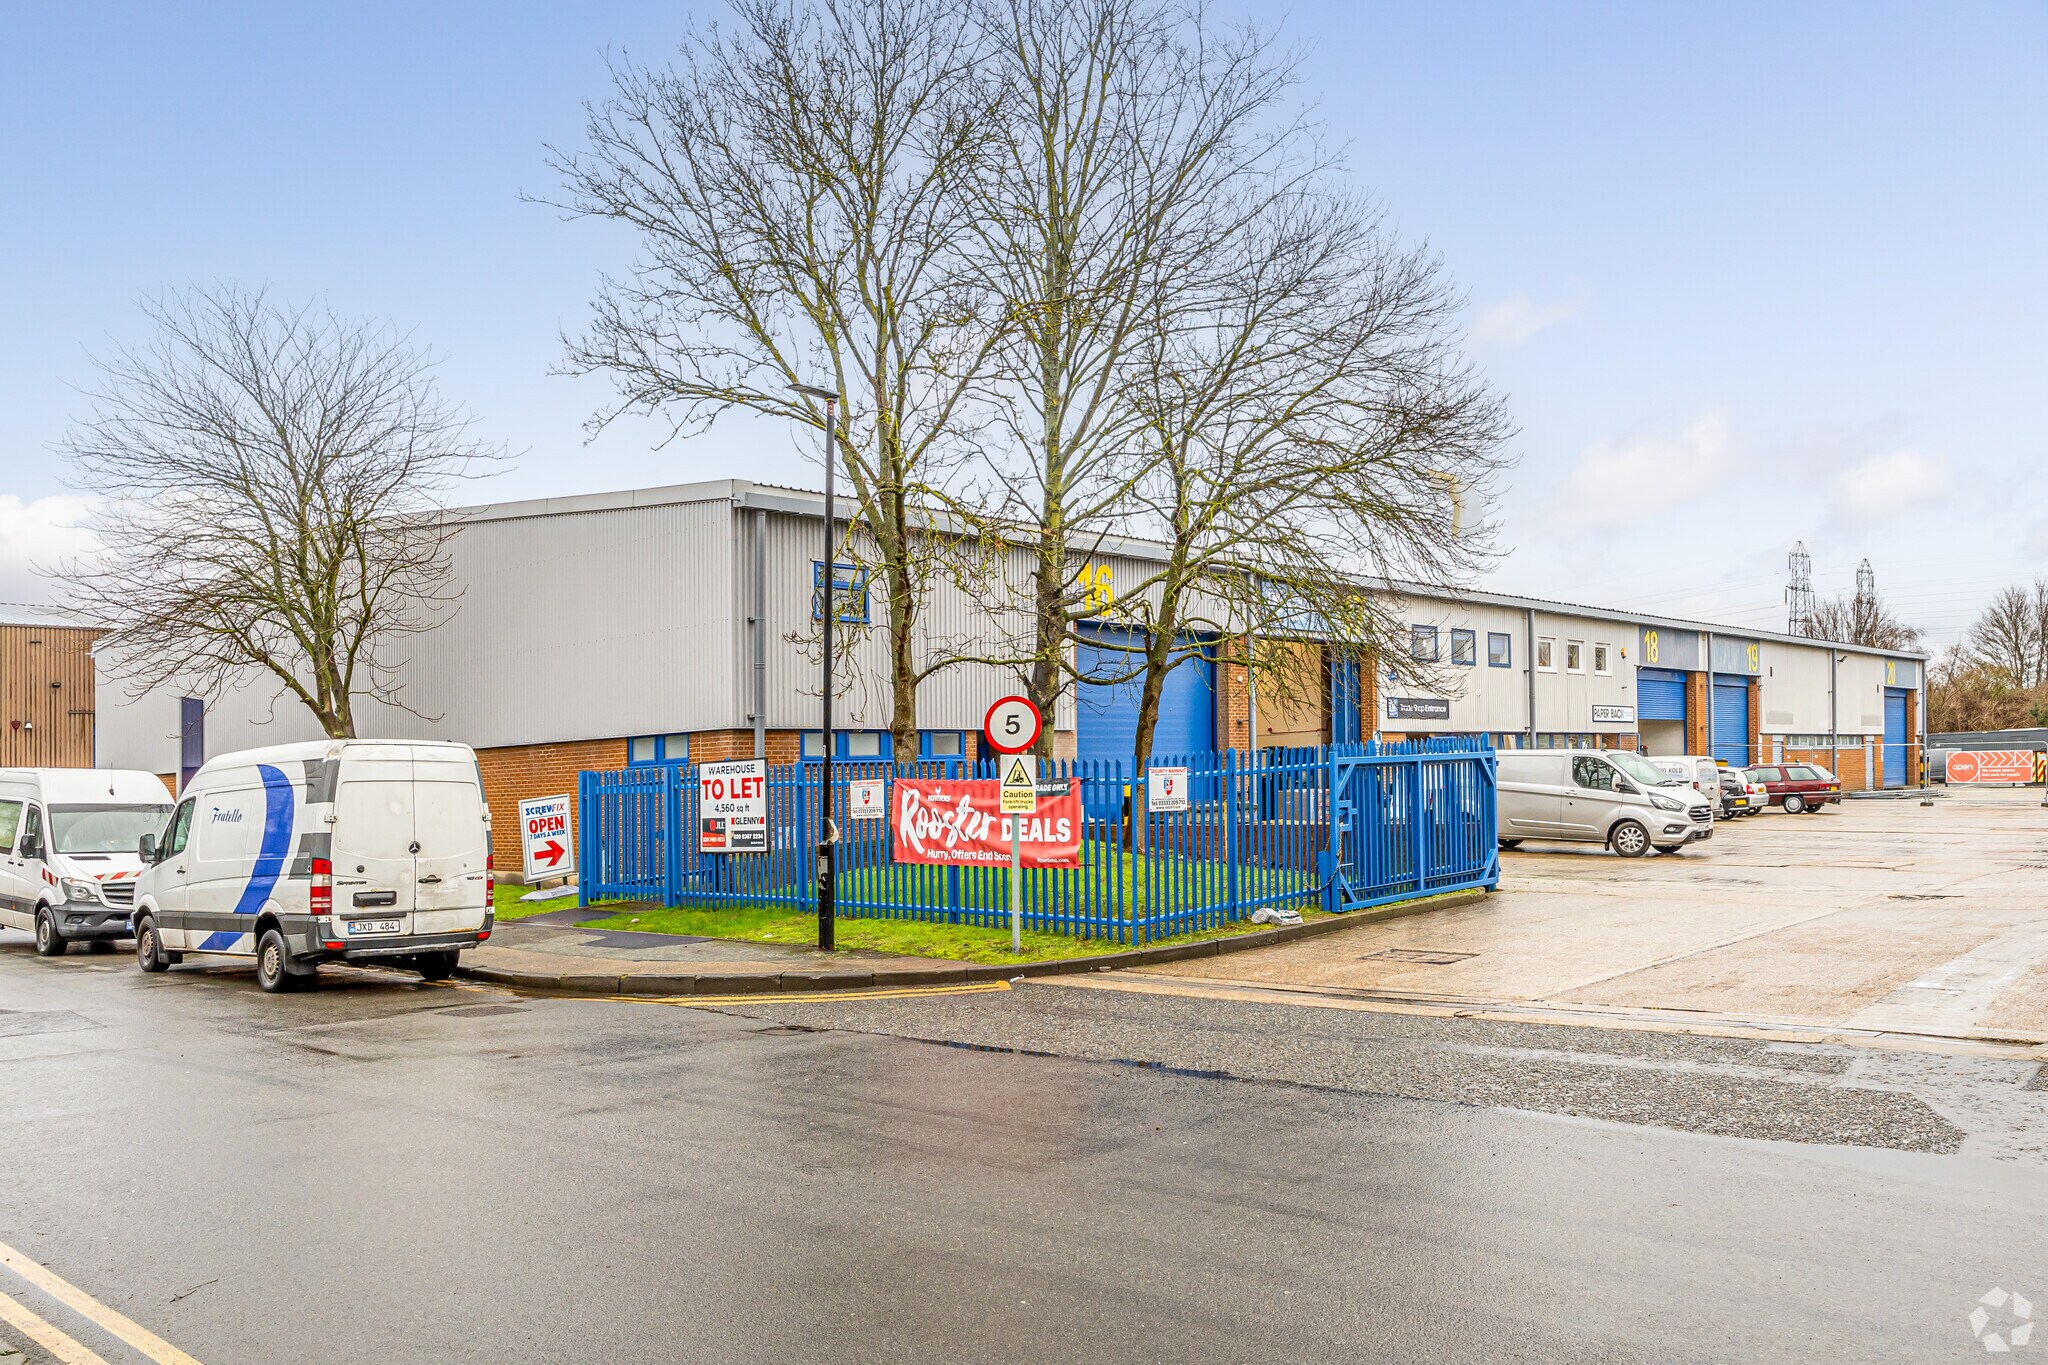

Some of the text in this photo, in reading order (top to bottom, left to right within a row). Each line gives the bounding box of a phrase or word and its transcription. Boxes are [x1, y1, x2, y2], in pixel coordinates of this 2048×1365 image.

[1077, 562, 1113, 617] 16
[1644, 630, 1658, 664] 18
[1746, 643, 1758, 672] 19
[1887, 661, 1896, 685] 20
[1425, 704, 1446, 713] Entrance
[1594, 708, 1609, 718] PAPER
[1611, 708, 1625, 718] BACK
[1005, 714, 1021, 735] 5
[708, 764, 755, 775] WAREHOUSE
[702, 777, 763, 800] TO LET
[1003, 790, 1034, 798] Caution
[1035, 783, 1068, 792] RADE ONLY
[211, 807, 243, 825] Fratello
[525, 803, 565, 816] SCREWFIX
[715, 803, 750, 814] 4,560 sq ft
[529, 815, 564, 834] OPEN
[735, 816, 760, 825] GLENNY
[900, 788, 997, 854] Rooster
[1000, 818, 1071, 842] DEALS
[927, 849, 950, 860] Hurry,
[952, 850, 976, 860] Offers
[978, 851, 993, 860] End
[356, 922, 373, 931] JXD
[379, 922, 395, 931] 484
